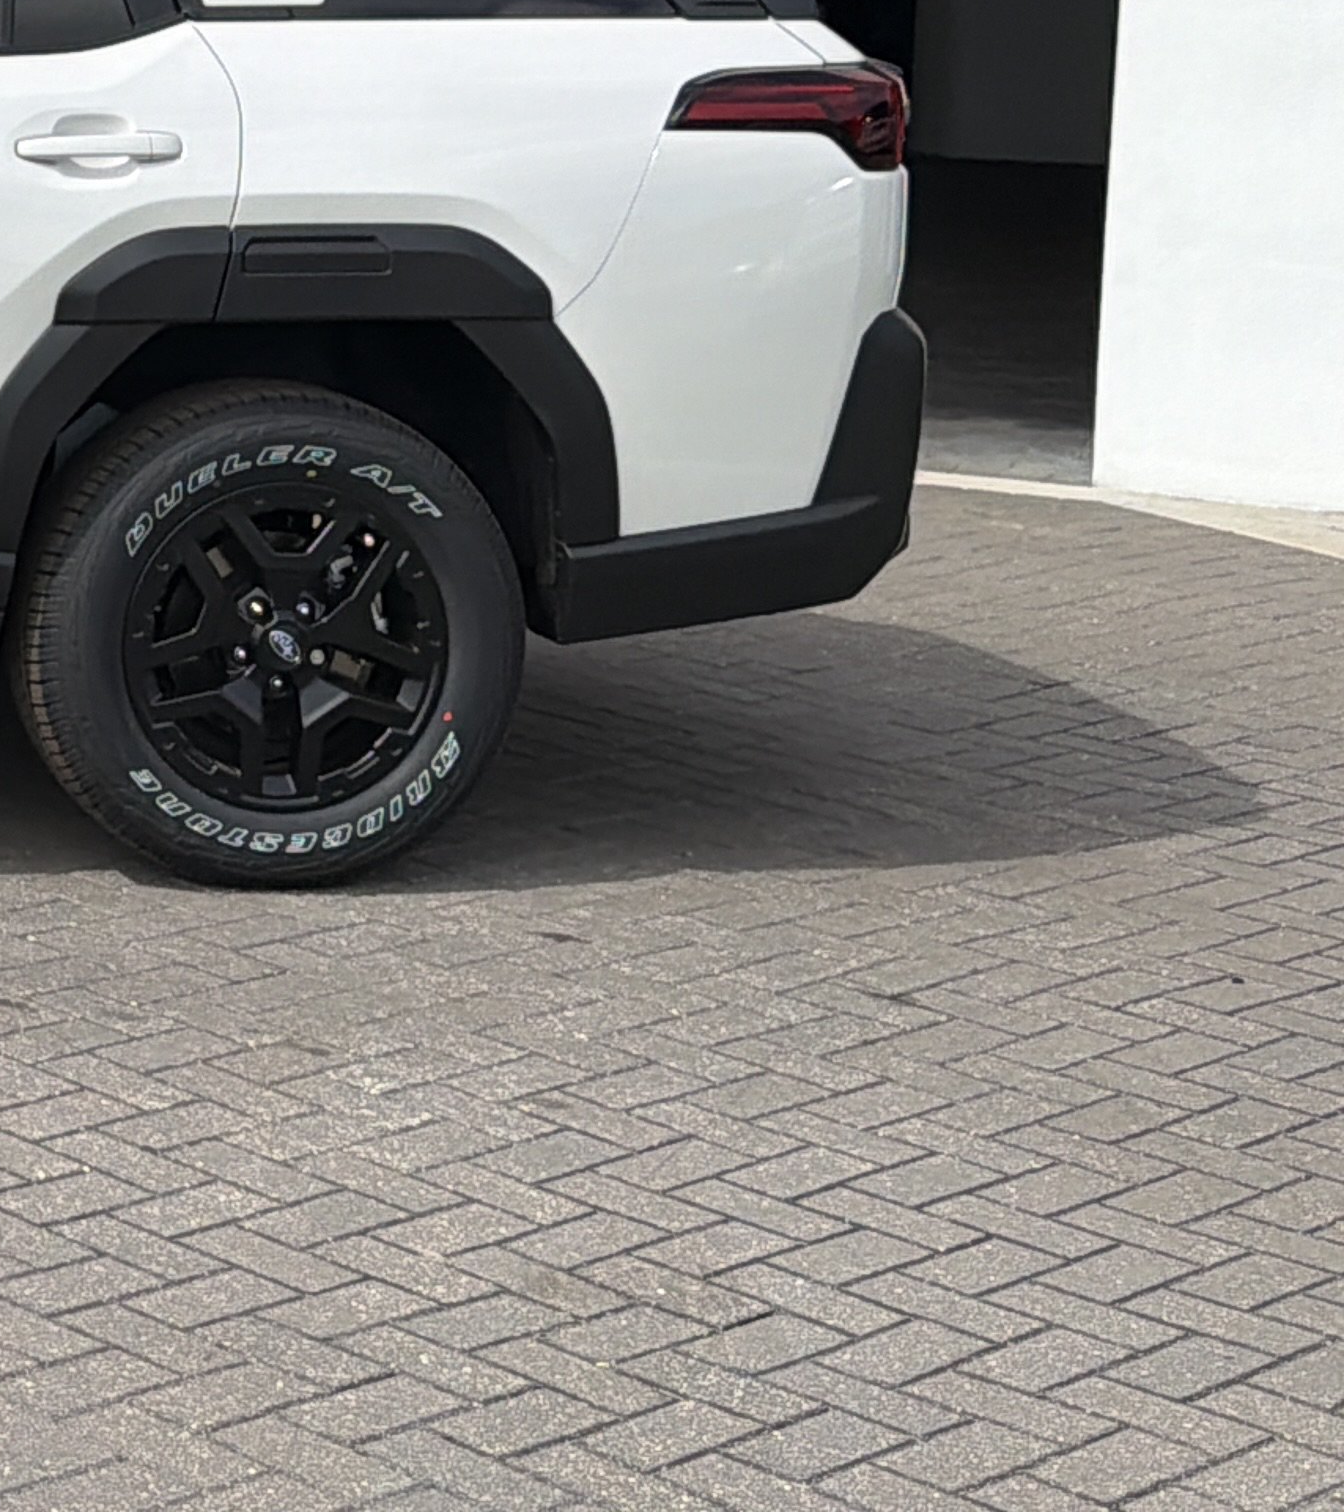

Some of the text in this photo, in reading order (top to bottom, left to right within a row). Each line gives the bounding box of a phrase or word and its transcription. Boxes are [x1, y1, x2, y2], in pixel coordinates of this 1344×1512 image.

[125, 445, 443, 557] DUELER A/T
[129, 731, 460, 854] BRIDGESTONE
